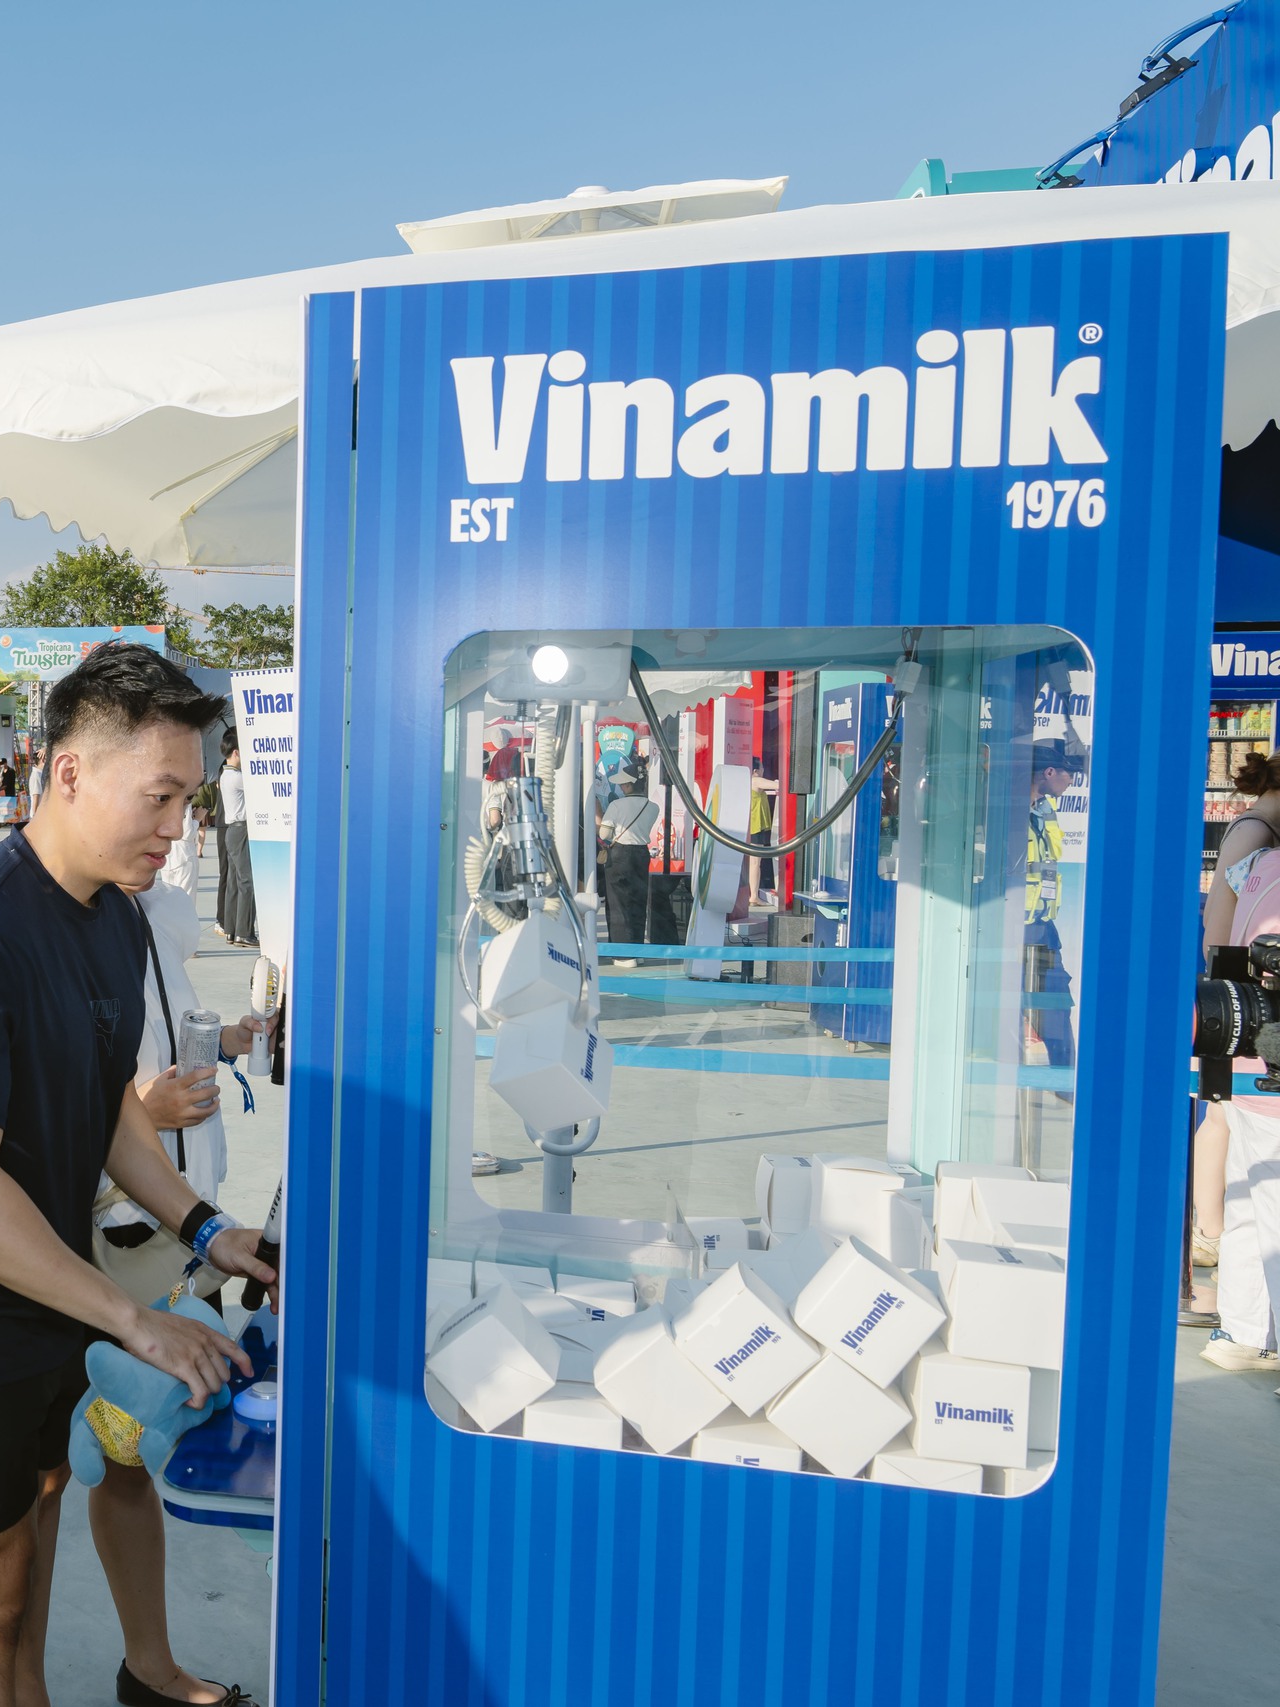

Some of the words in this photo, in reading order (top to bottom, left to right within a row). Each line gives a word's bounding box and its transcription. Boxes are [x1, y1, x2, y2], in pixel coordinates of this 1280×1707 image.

[450, 325, 1108, 485] Vinamilk
[449, 497, 514, 544] EST
[1005, 479, 1106, 530] 1976
[39, 642, 72, 652] Tropicana
[13, 650, 77, 670] Twister
[246, 717, 255, 726] EST
[1232, 998, 1241, 1011] OF
[1233, 1012, 1241, 1036] CLUB
[1226, 1037, 1239, 1055] BMW
[840, 1290, 898, 1349] Vinamilk
[713, 1325, 776, 1375] Vinamilk
[935, 1401, 1014, 1425] Vinamilk
